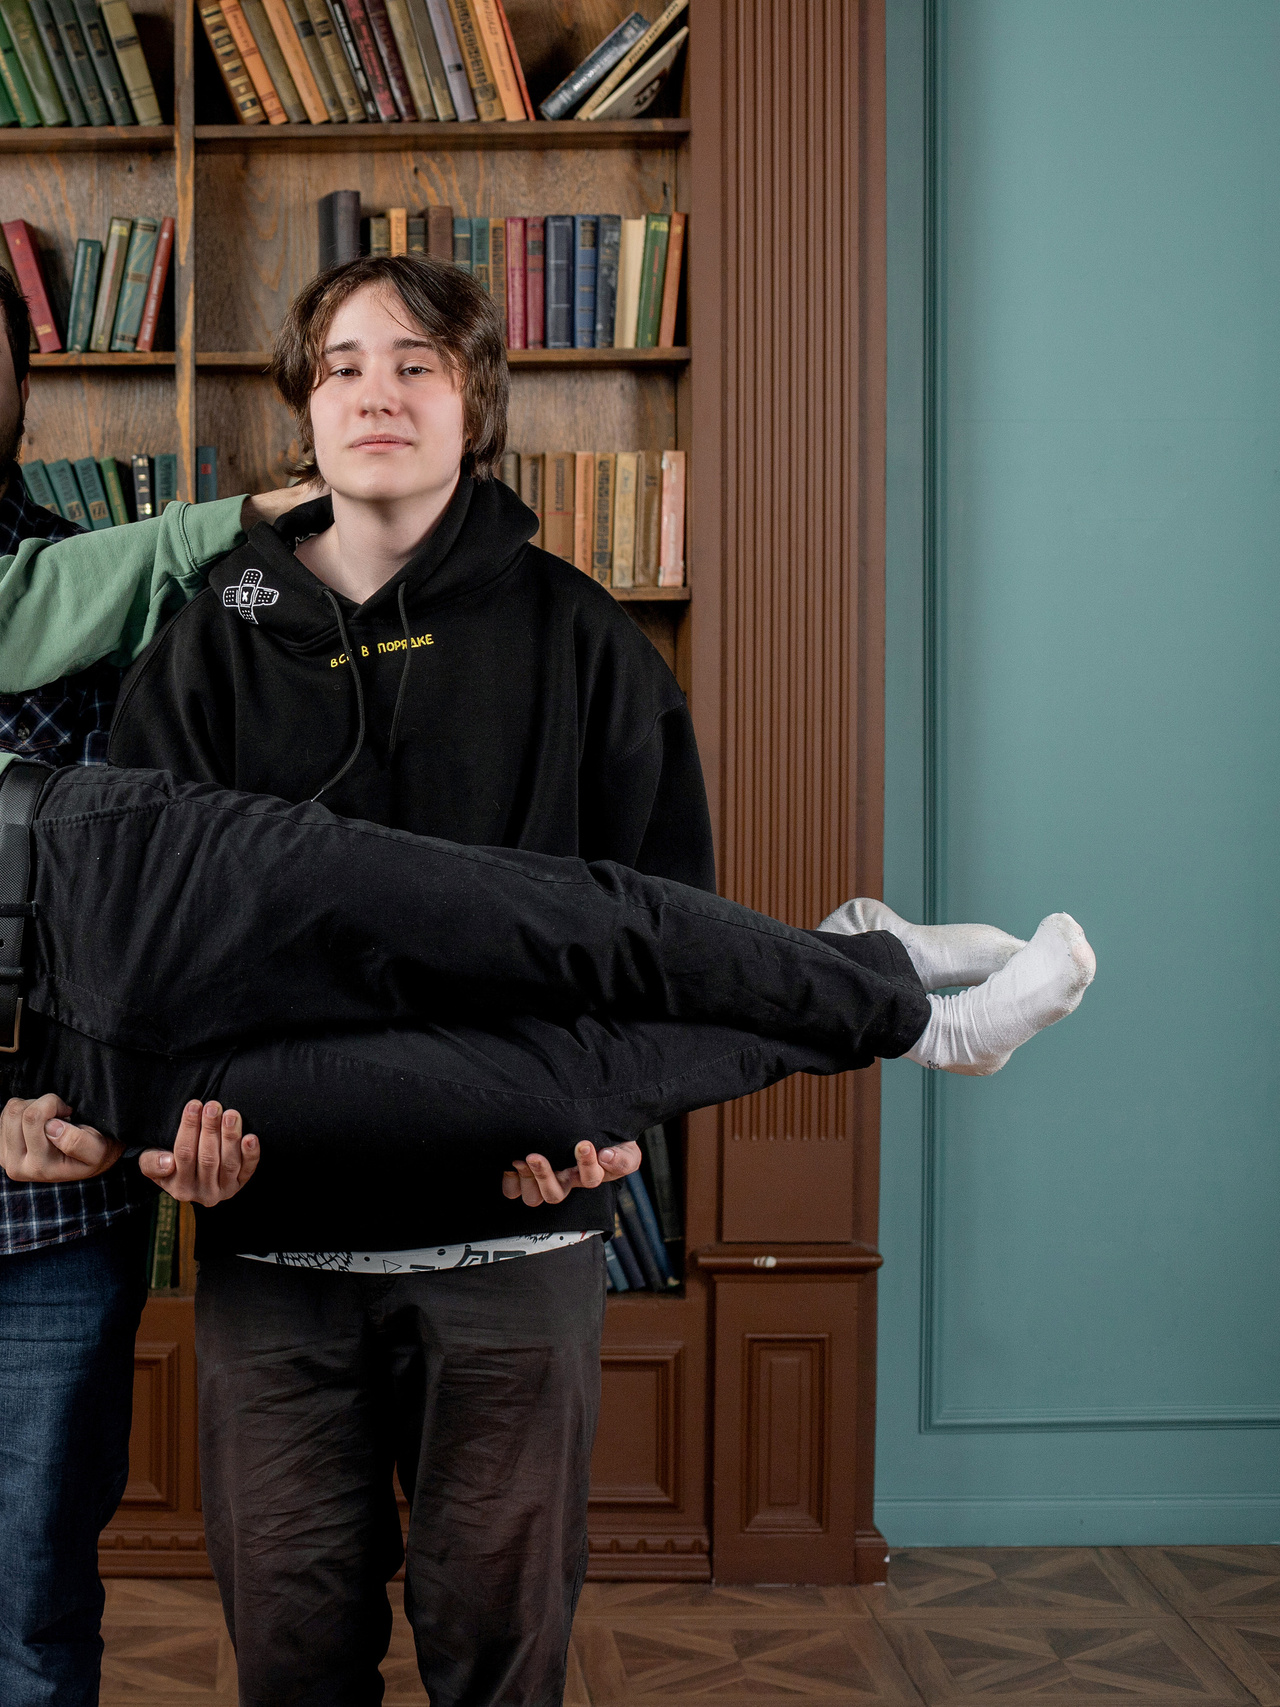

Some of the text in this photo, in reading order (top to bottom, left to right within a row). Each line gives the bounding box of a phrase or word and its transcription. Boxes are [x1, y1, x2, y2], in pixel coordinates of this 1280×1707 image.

[330, 633, 434, 668] ВС В ПОРЯДКЕ
